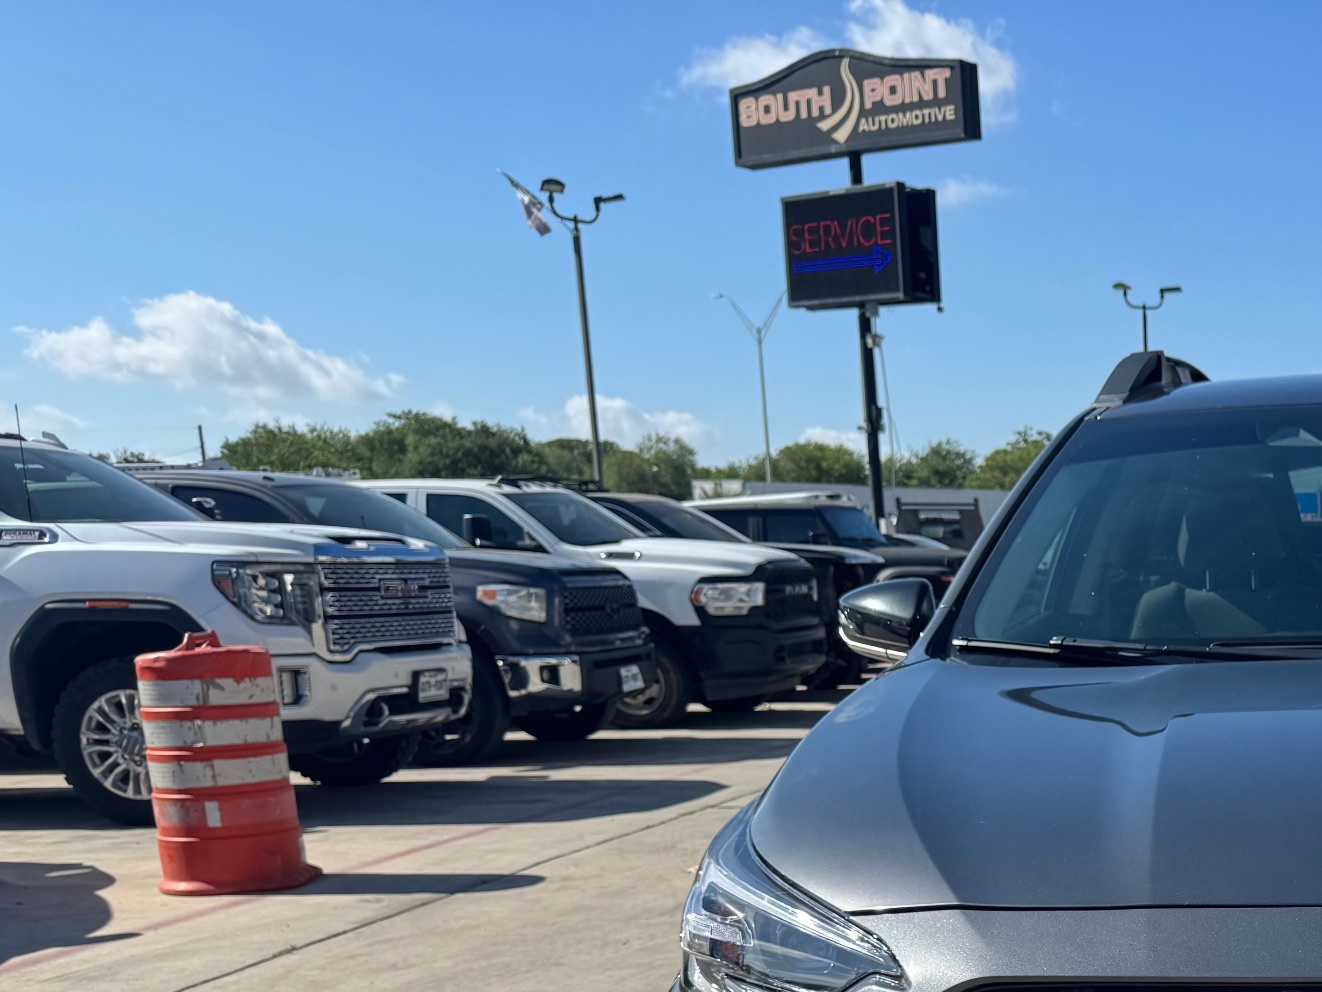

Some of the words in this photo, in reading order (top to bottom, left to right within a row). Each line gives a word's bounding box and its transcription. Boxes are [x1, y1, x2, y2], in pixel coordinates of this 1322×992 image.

[738, 86, 832, 128] SOUTH
[862, 67, 950, 110] POINT
[858, 105, 956, 133] AUTOMOTIVE
[789, 213, 892, 255] SERVICE
